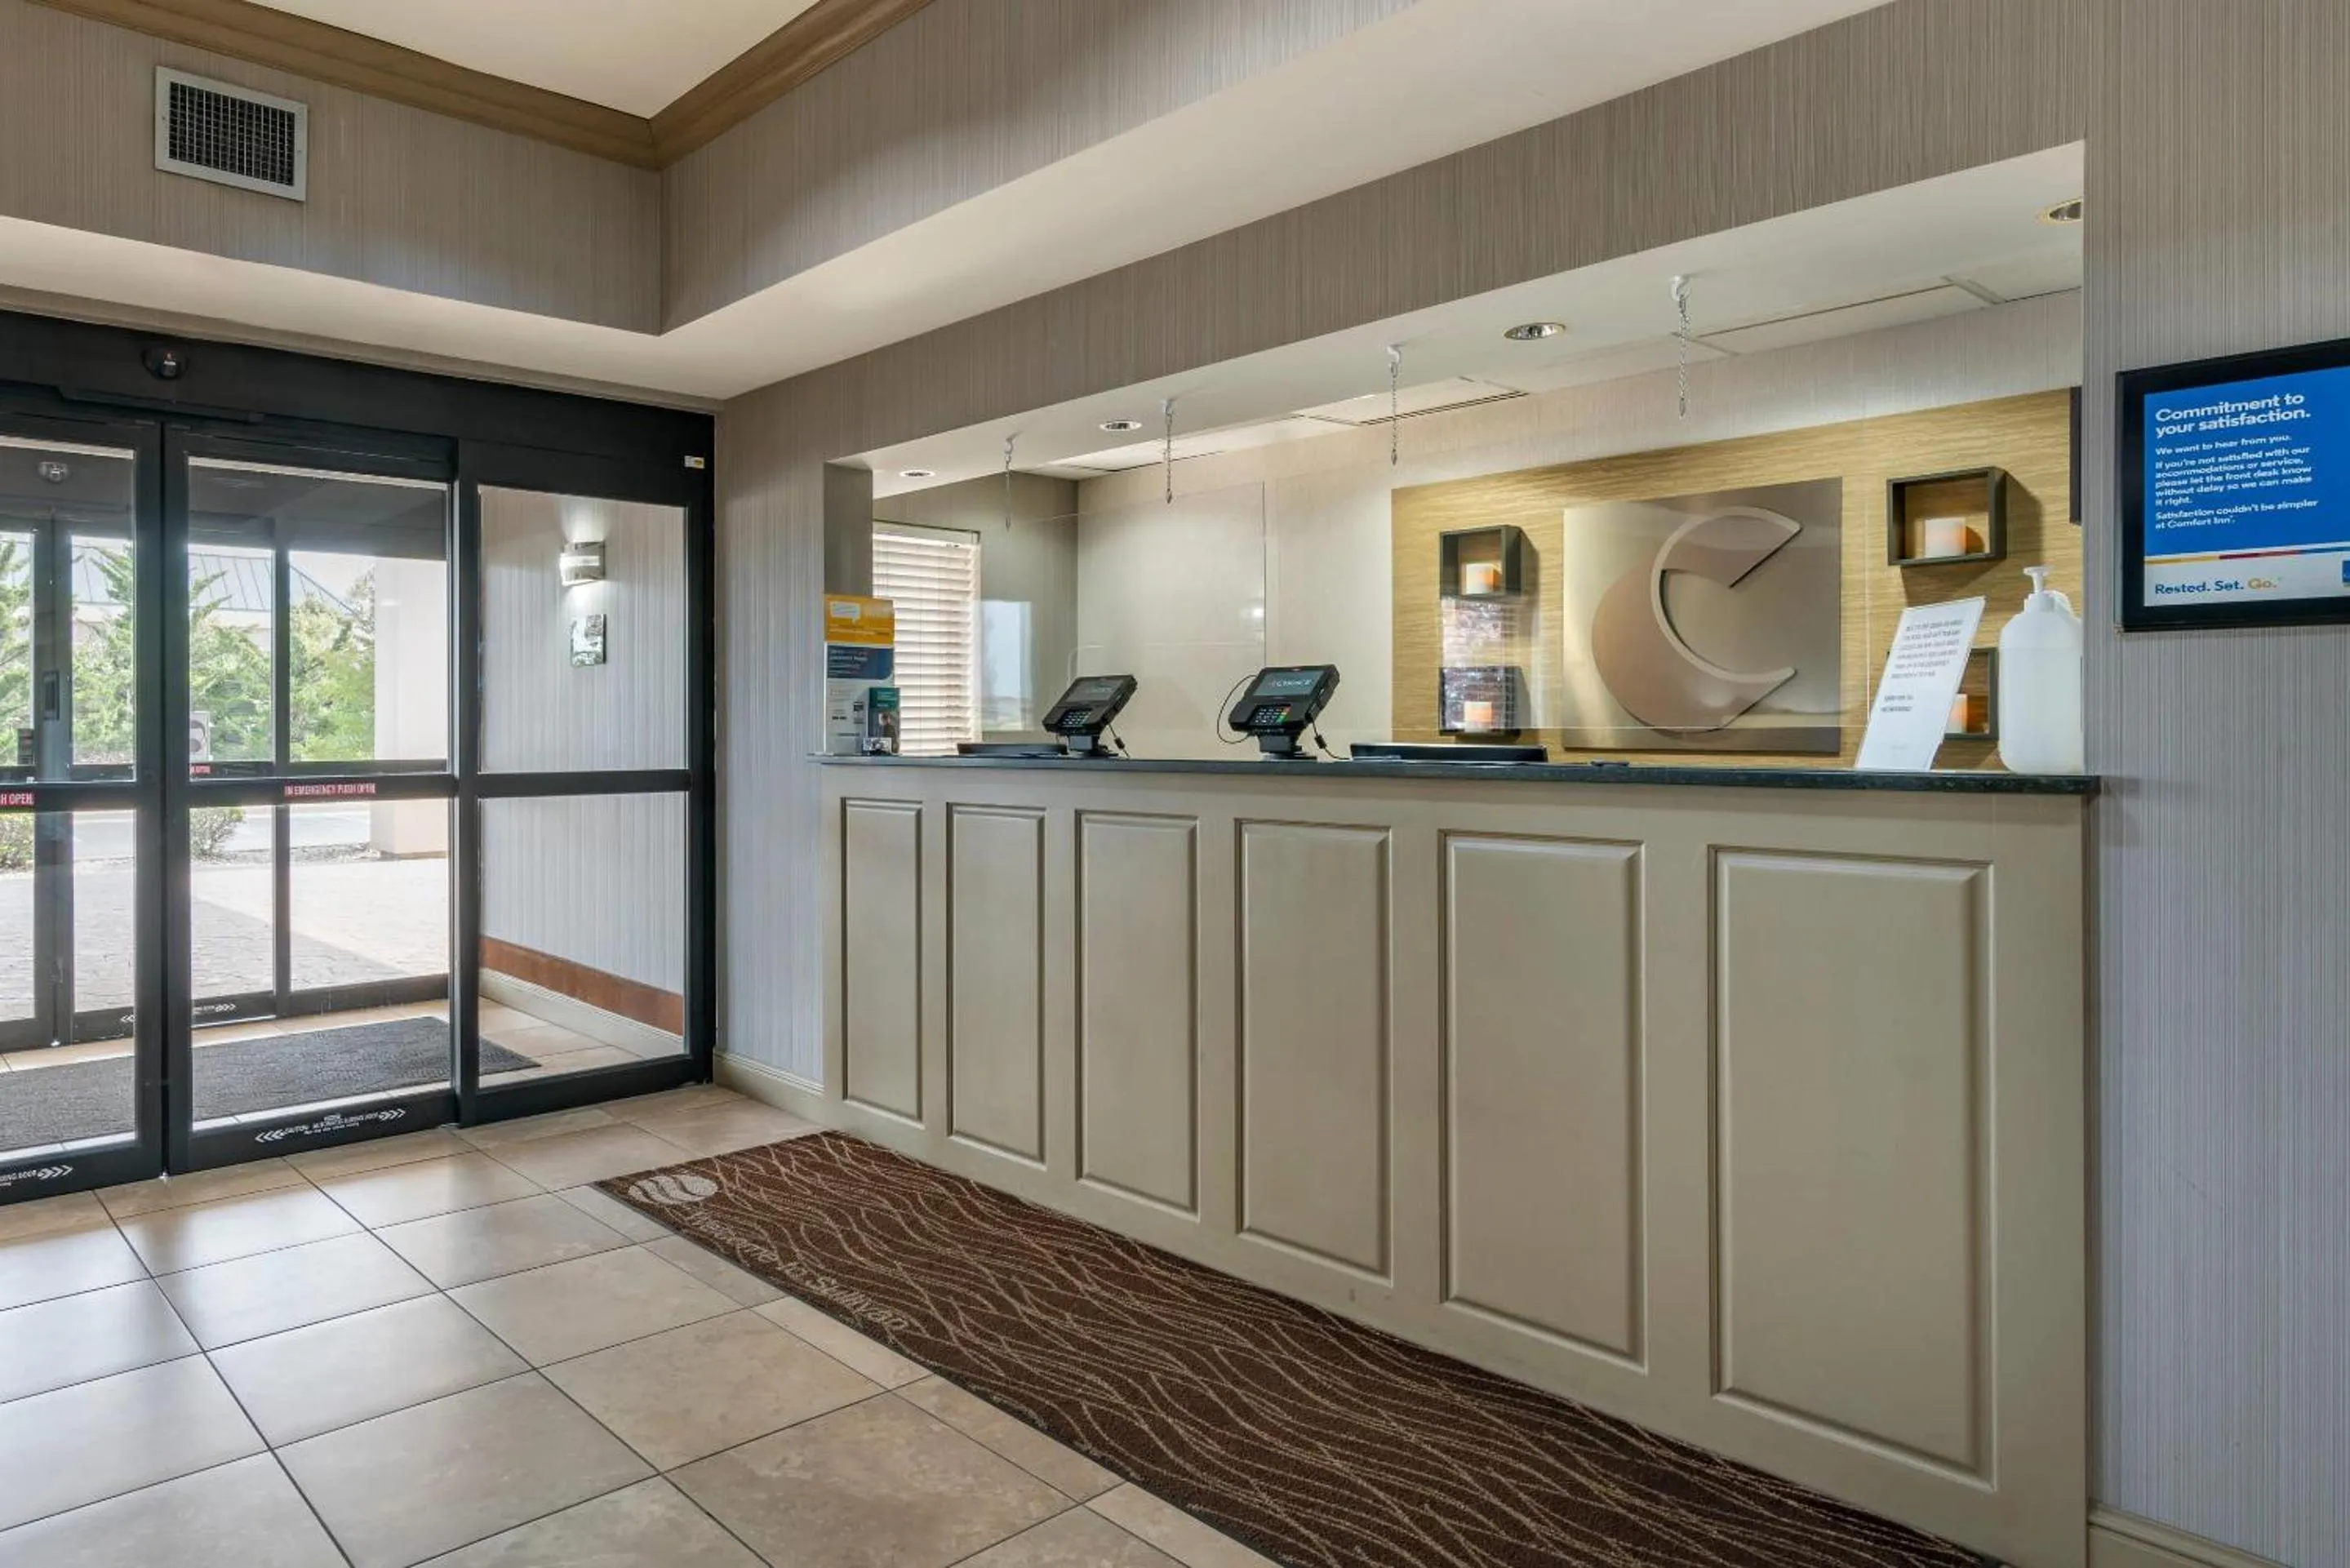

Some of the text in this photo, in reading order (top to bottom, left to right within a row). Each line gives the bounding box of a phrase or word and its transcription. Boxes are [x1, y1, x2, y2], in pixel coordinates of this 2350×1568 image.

[2155, 393, 2304, 422] Commitment to
[2155, 408, 2312, 439] your satisfaction.
[2155, 447, 2174, 455] We
[2175, 445, 2200, 453] want
[2215, 440, 2238, 449] hear
[2241, 438, 2267, 446] from
[2269, 434, 2292, 444] you.
[2155, 446, 2312, 470] If you're not satisfied with our
[2155, 463, 2245, 478] accommodations
[2260, 457, 2304, 468] service,
[2155, 466, 2312, 489] please let the front desk know
[2155, 487, 2194, 497] without
[2197, 483, 2224, 493] delay
[2259, 479, 2280, 487] can
[2281, 475, 2312, 485] make
[2155, 495, 2193, 506] it right.
[2155, 499, 2319, 520] Satisfaction couldn't be simpler
[2167, 517, 2212, 529] Comfort
[2154, 581, 2211, 595] Rested.
[2215, 580, 2245, 592] Set.
[9, 792, 34, 806] OPEN
